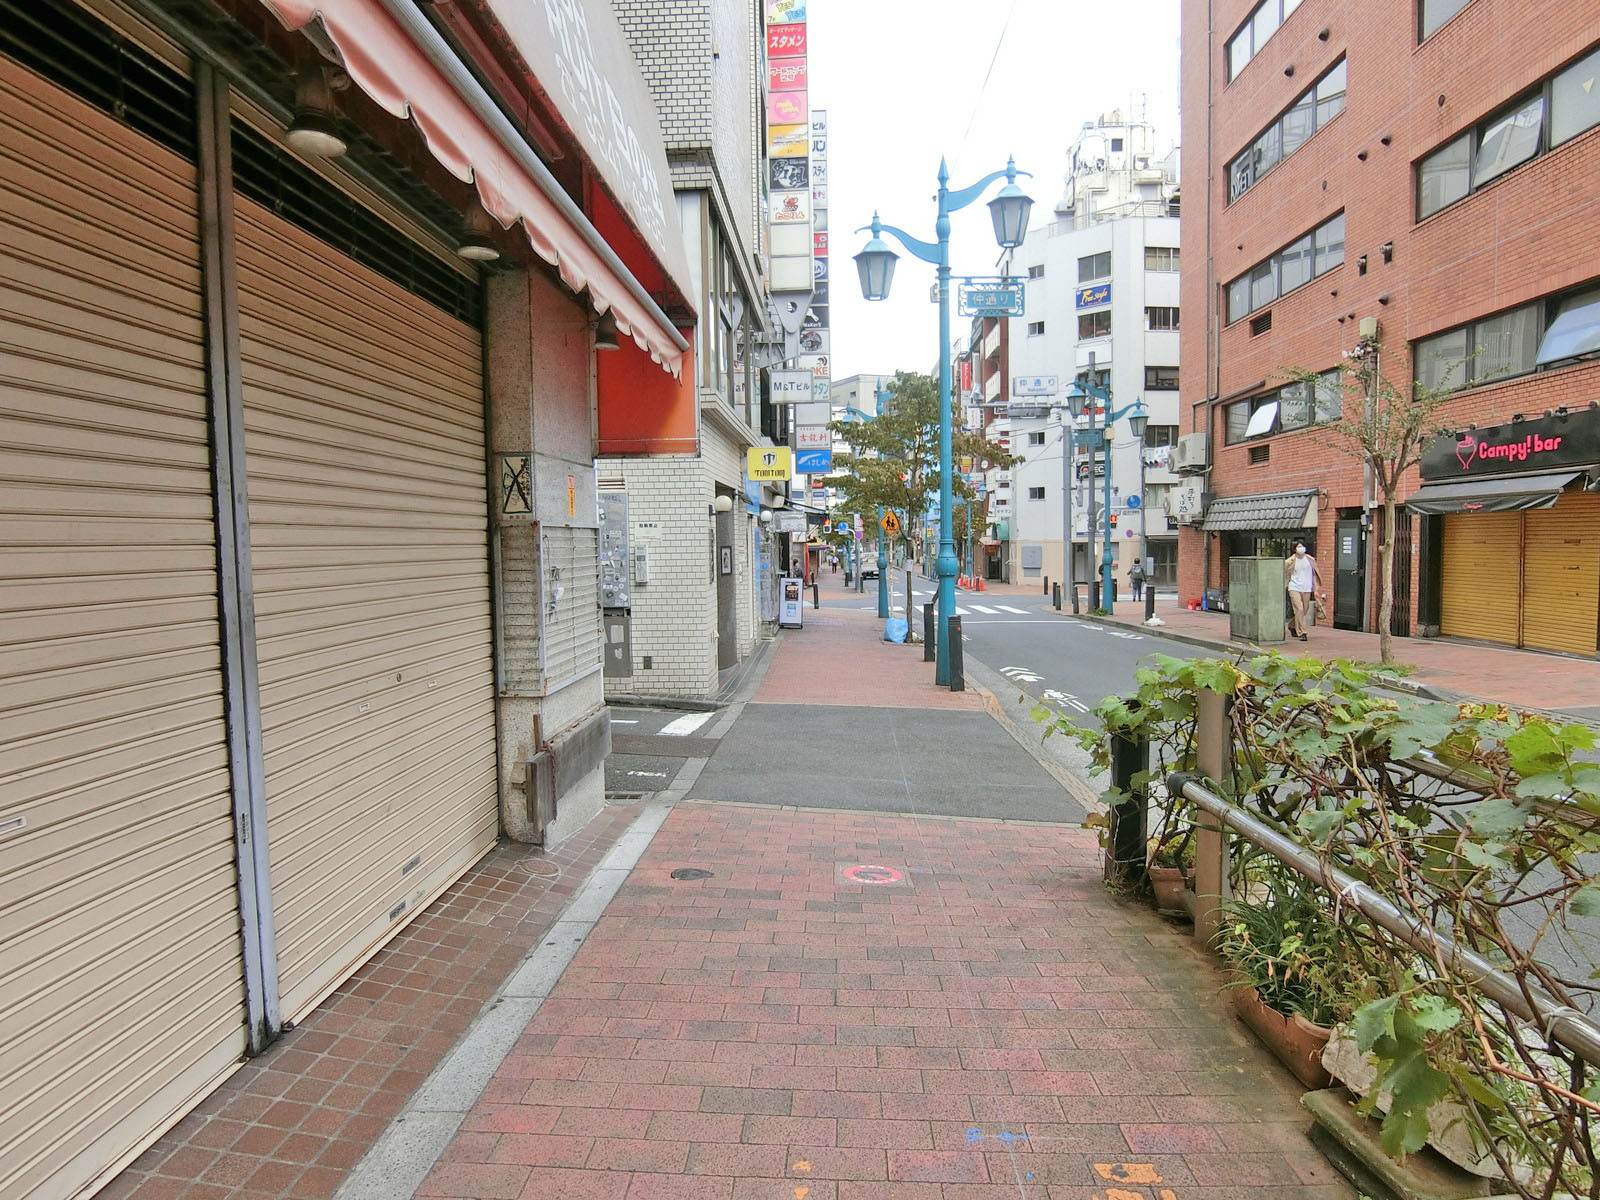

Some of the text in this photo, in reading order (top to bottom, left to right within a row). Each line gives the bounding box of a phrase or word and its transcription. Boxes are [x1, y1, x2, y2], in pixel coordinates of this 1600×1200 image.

[769, 35, 805, 48] スタメン
[972, 293, 1009, 305] 仲通り
[1019, 378, 1056, 388] 仲通り
[1479, 434, 1562, 462] Campy! bar
